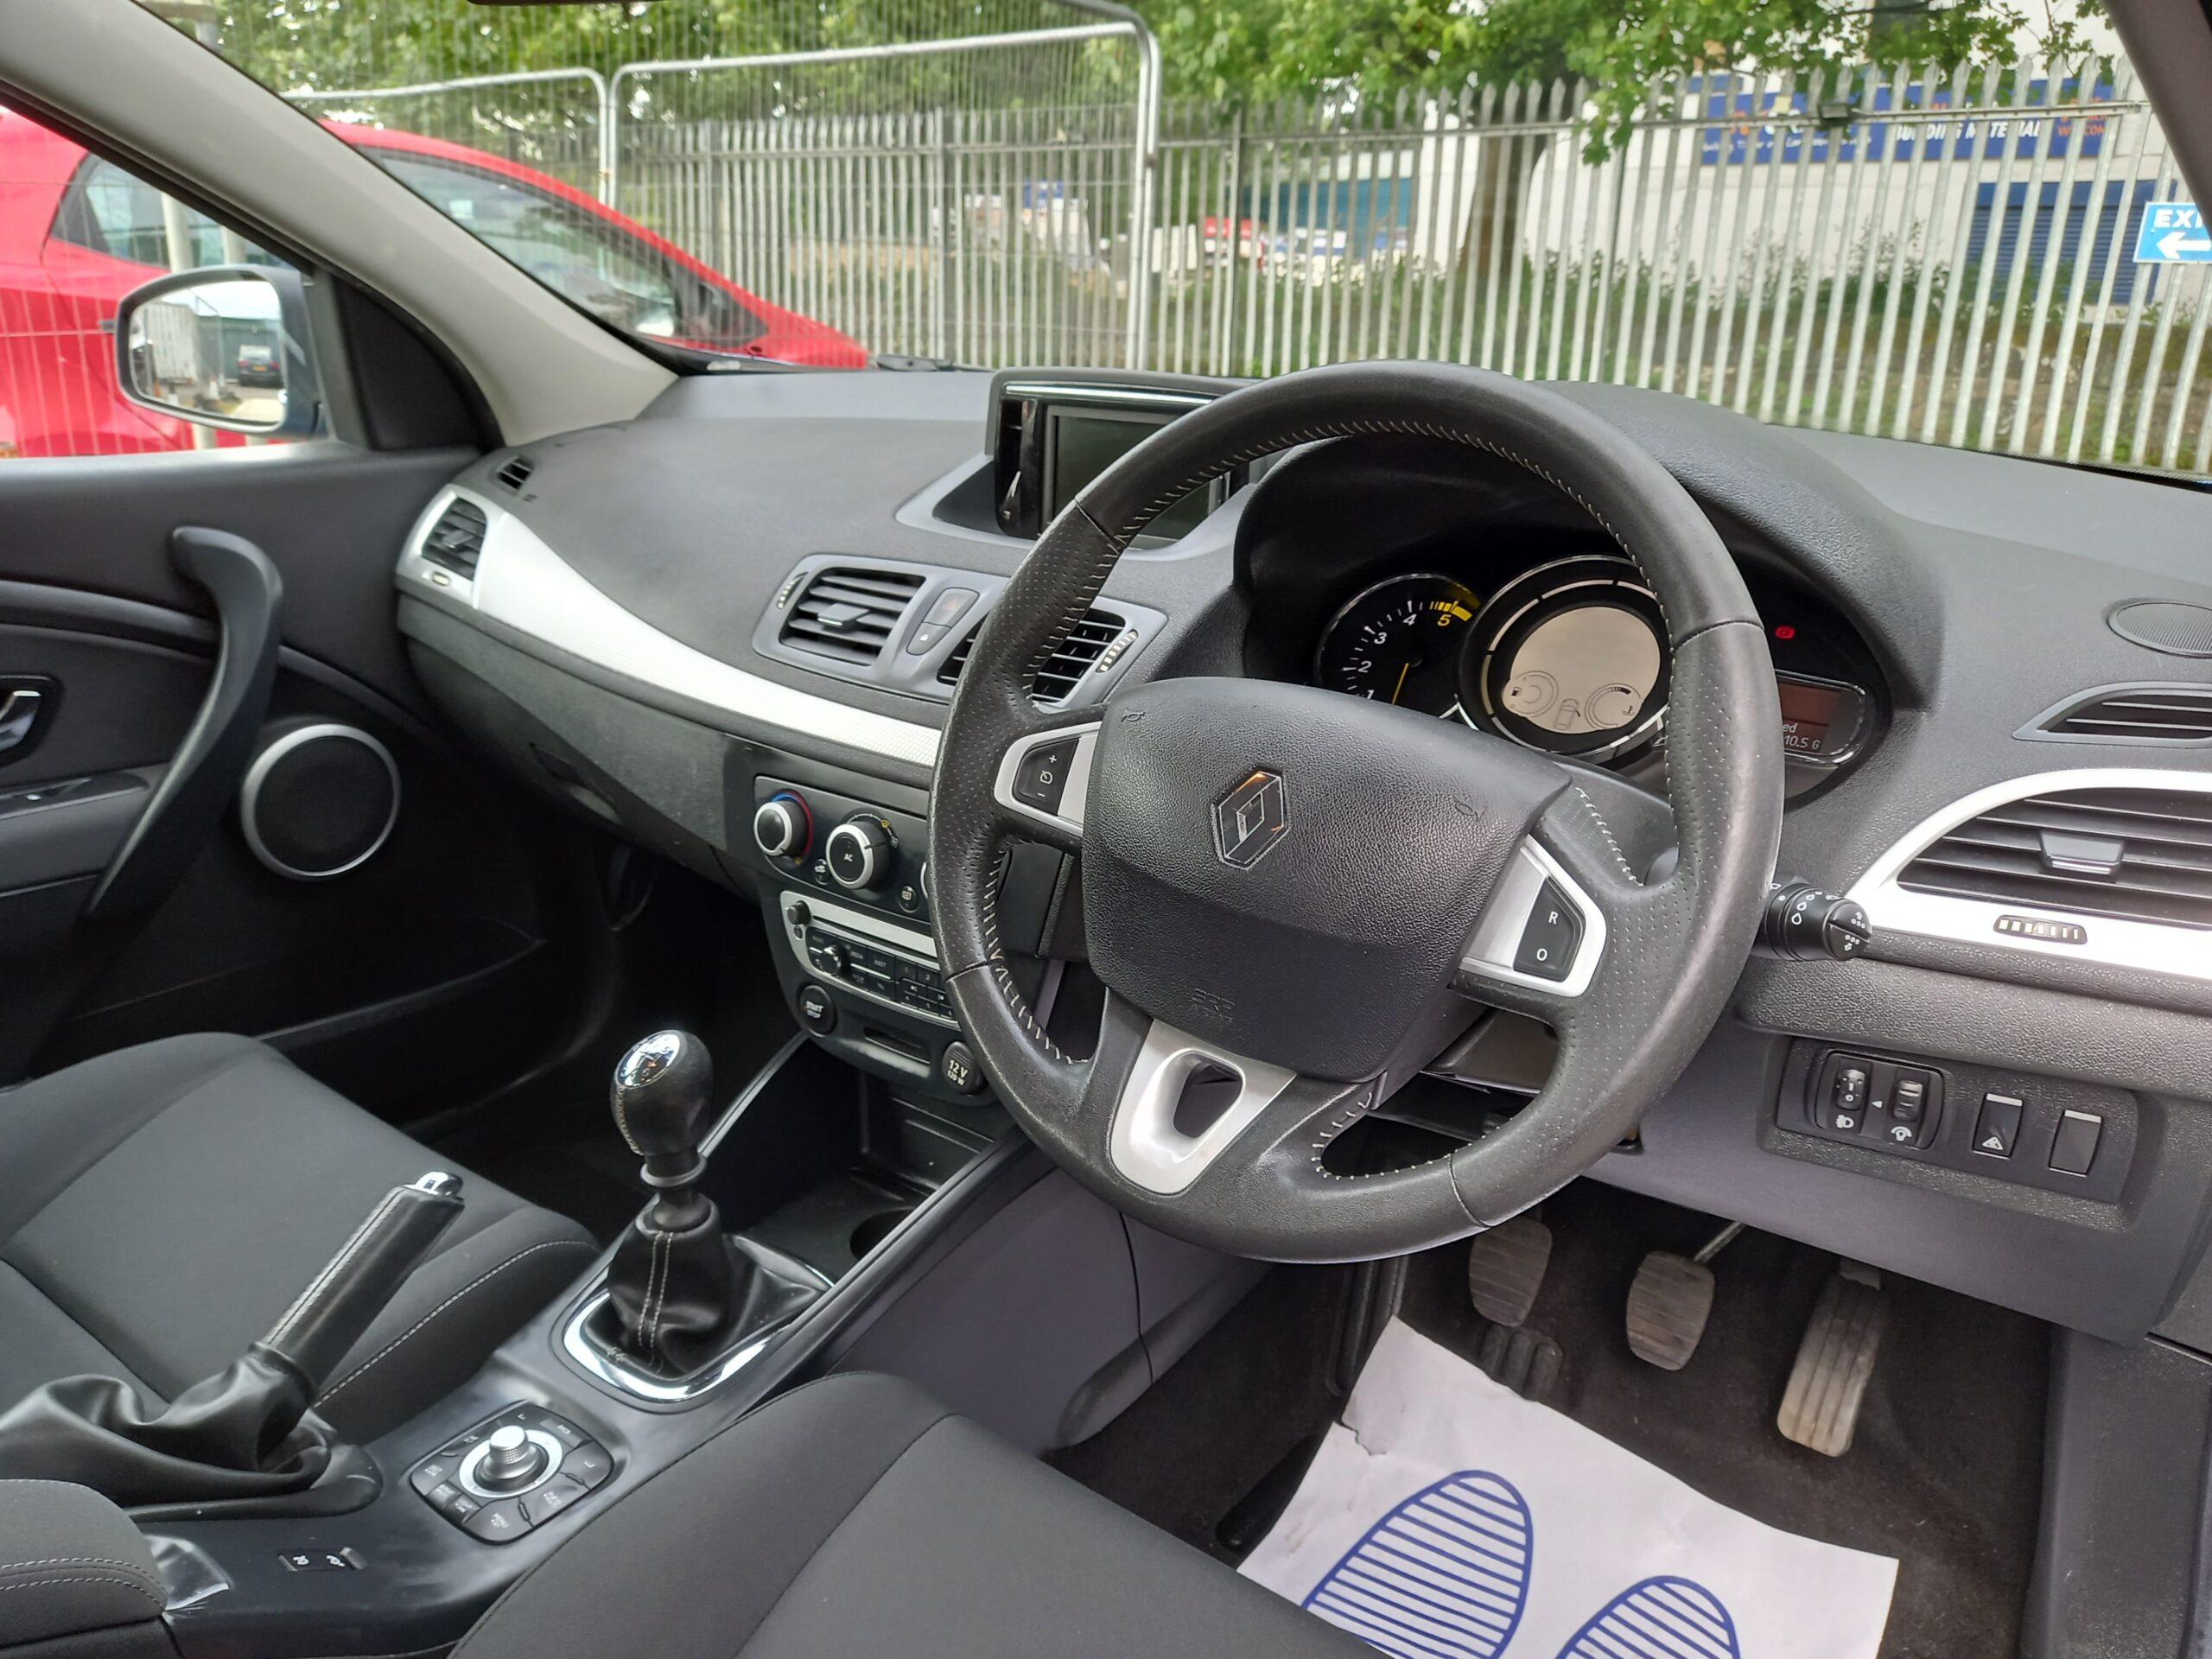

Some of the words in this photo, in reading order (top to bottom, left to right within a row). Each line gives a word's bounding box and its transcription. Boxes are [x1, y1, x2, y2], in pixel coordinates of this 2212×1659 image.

[1403, 613, 1417, 626] 4
[1437, 614, 1452, 626] 5
[1374, 632, 1388, 645] 3
[1357, 661, 1372, 673] 2
[1367, 690, 1375, 700] 1
[1811, 740, 1821, 750] G
[843, 853, 854, 862] AC
[1548, 911, 1559, 925] R
[949, 1059, 960, 1074] 12
[960, 1066, 969, 1078] V
